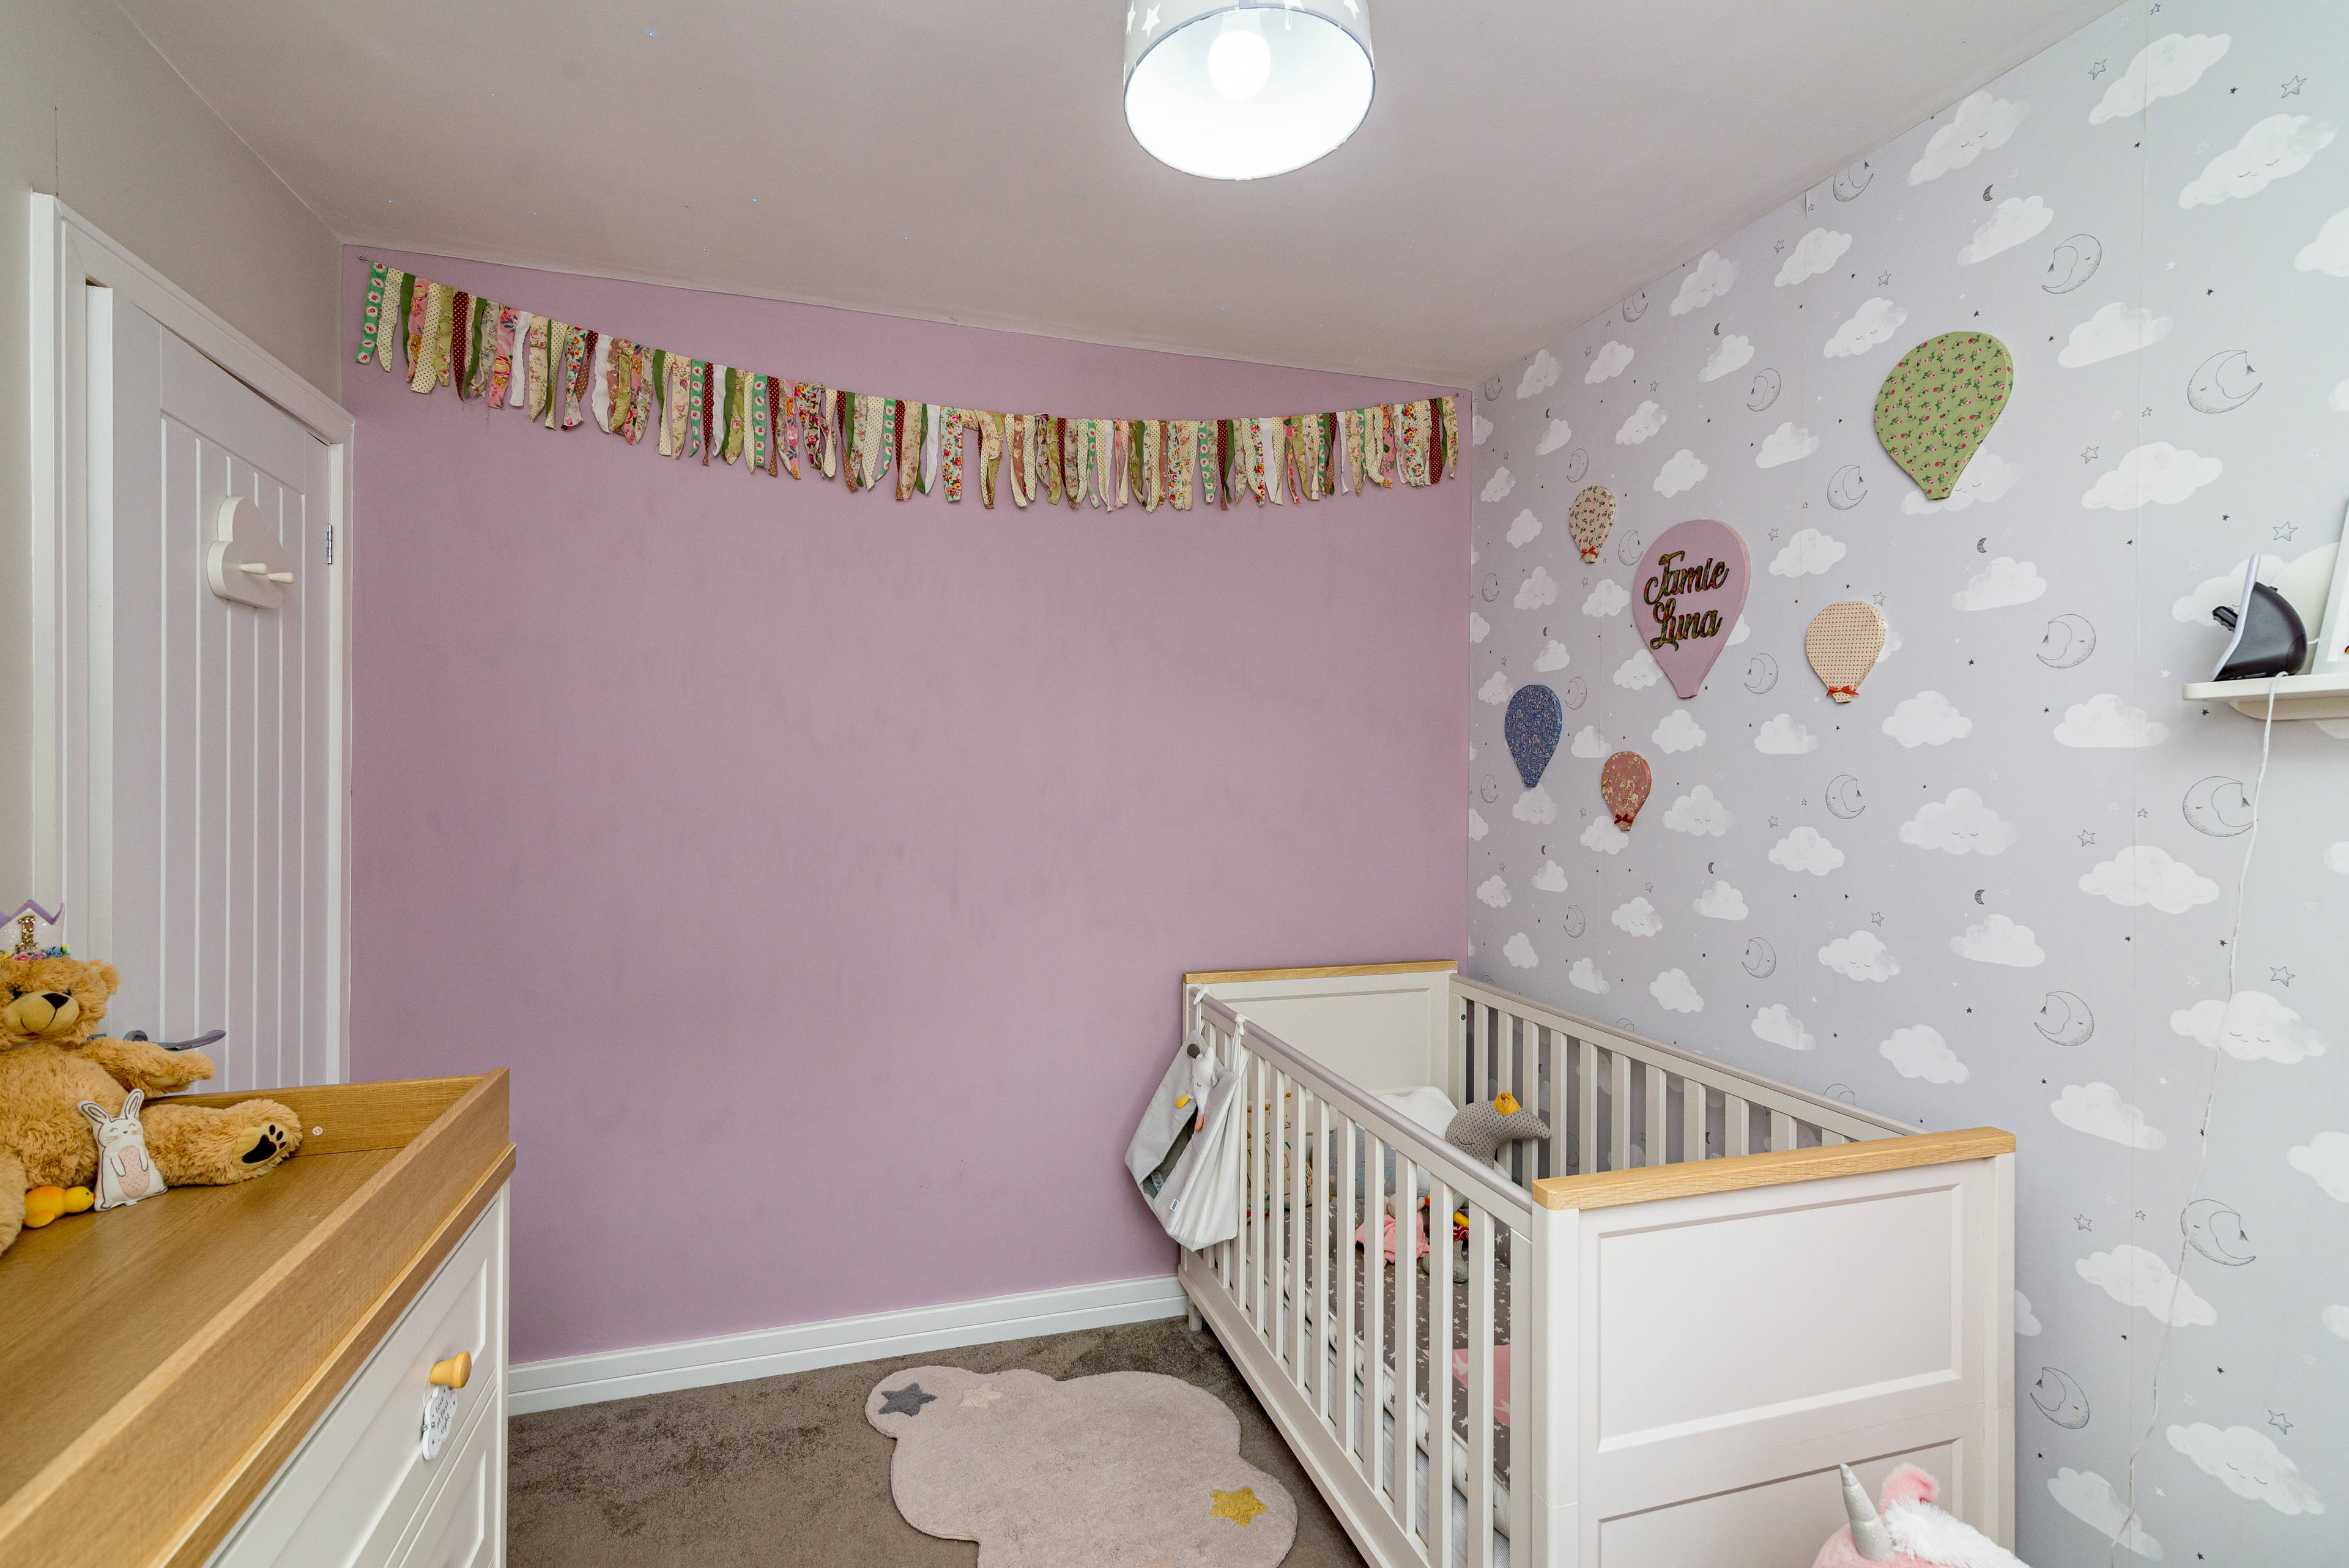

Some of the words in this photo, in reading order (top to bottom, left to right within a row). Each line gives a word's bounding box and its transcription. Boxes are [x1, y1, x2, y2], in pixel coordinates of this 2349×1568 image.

[1644, 550, 1729, 605] Jamie
[1650, 597, 1723, 651] Luna
[15, 915, 39, 951] 1
[435, 1396, 443, 1413] love
[437, 1418, 441, 1429] at
[440, 1399, 449, 1419] first
[441, 1413, 450, 1435] sight
